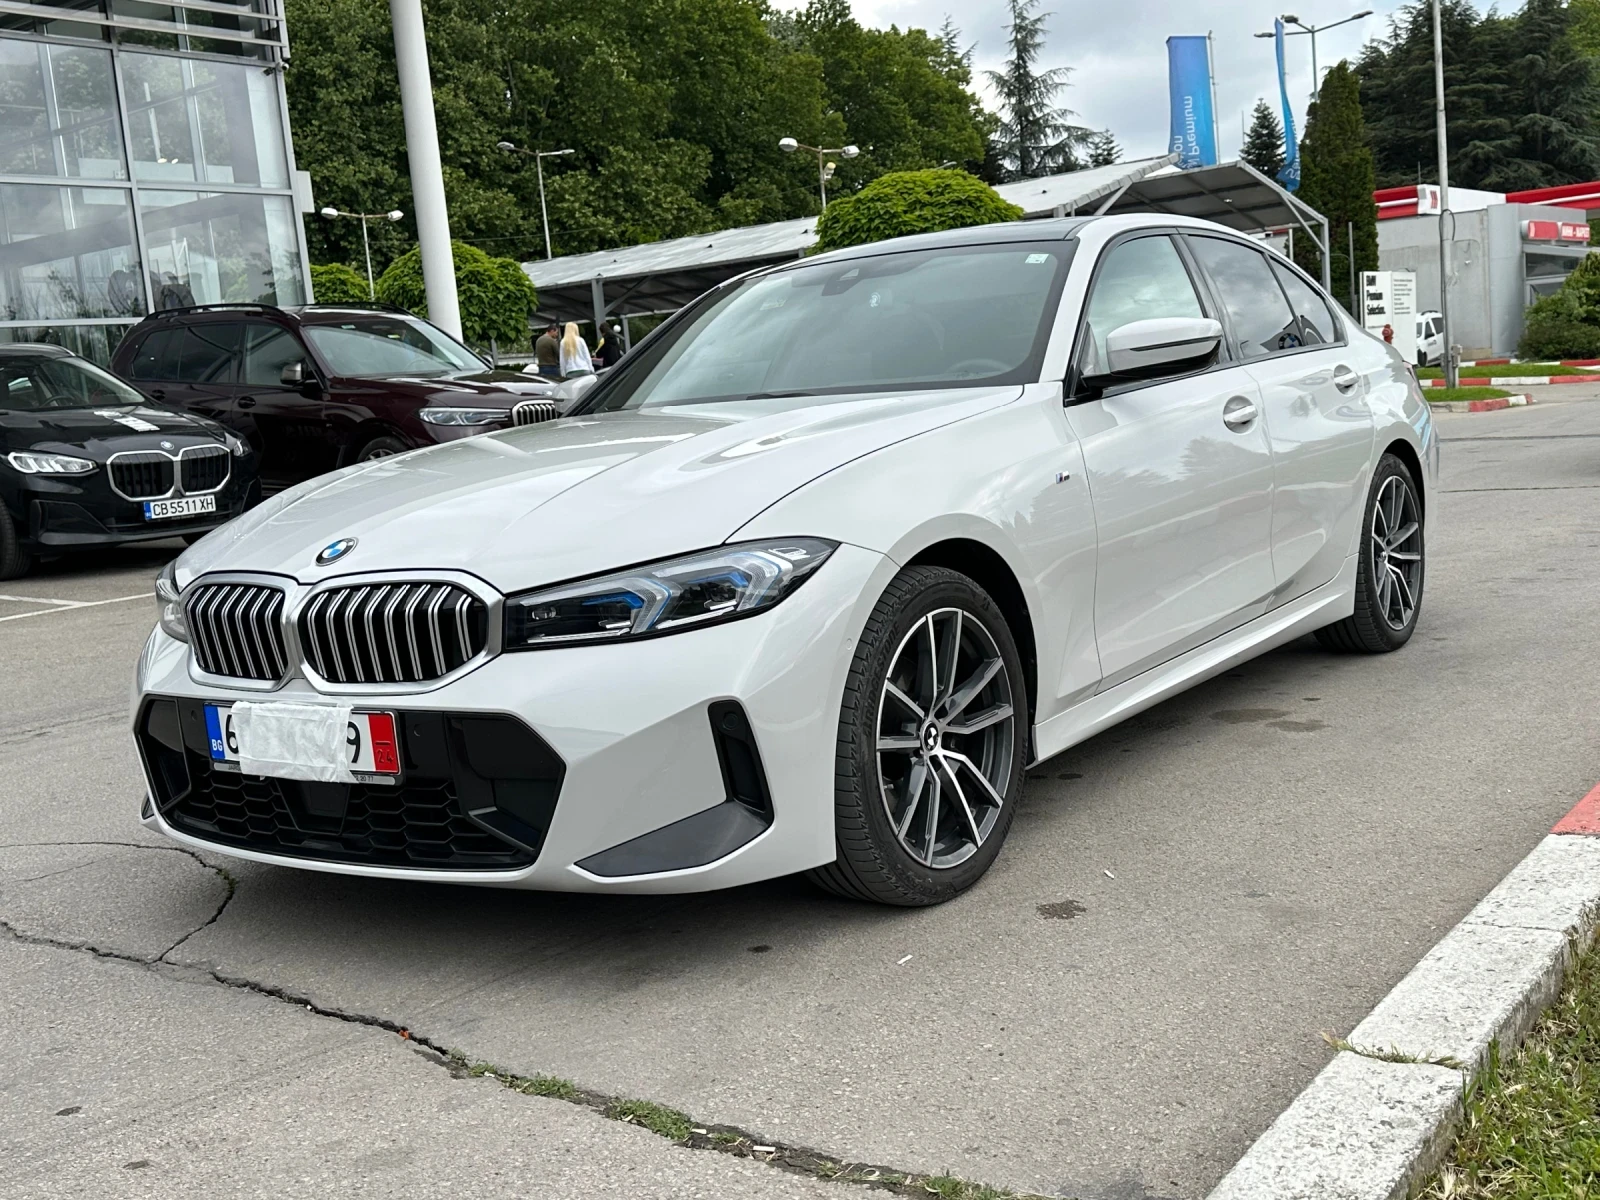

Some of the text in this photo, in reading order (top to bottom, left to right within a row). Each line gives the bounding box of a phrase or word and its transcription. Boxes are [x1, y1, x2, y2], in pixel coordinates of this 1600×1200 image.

[153, 503, 168, 516] CB
[170, 499, 197, 514] 5511
[199, 497, 214, 511] XH
[211, 738, 223, 752] BG
